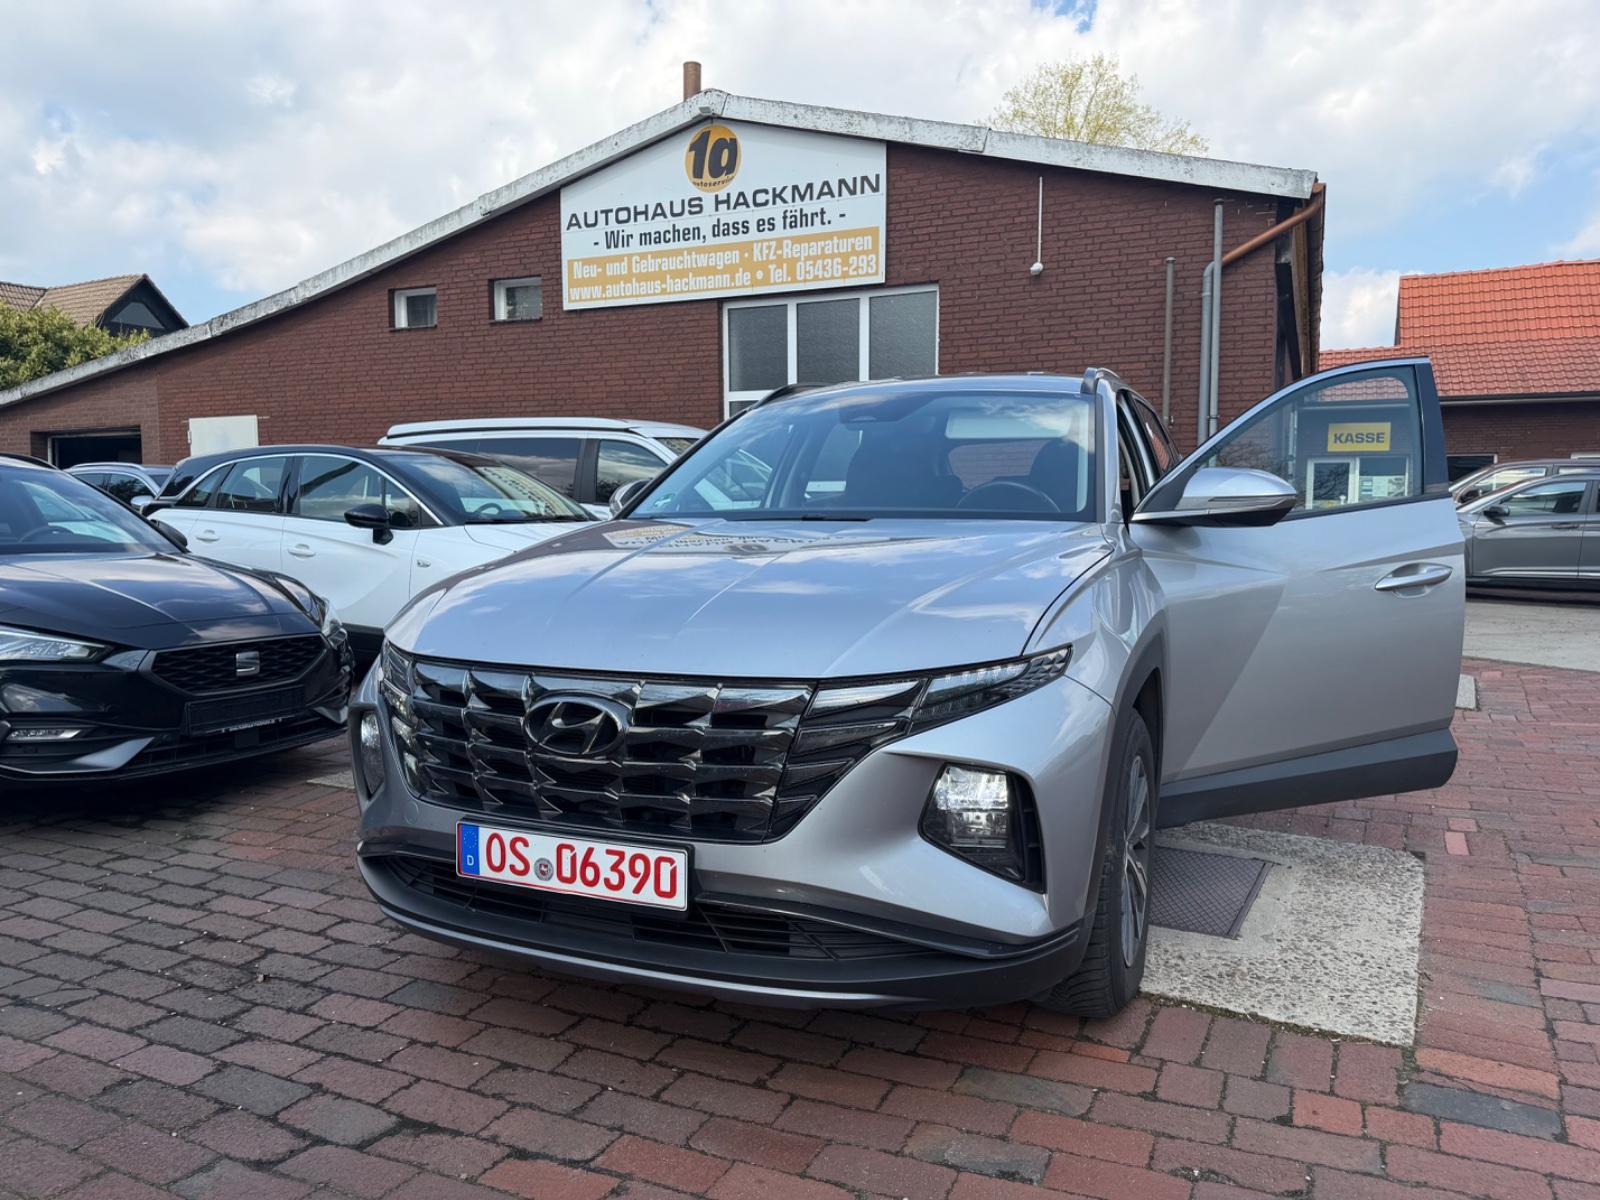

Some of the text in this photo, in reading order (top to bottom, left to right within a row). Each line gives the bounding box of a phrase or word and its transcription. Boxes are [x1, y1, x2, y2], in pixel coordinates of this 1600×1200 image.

[689, 130, 738, 179] 1a
[566, 173, 880, 230] AUTOHAUS HACKMANN
[605, 229, 633, 249] Wir
[639, 223, 706, 246] machen,
[712, 217, 750, 238] dass
[756, 216, 776, 233] es
[782, 207, 831, 230] fährt.
[570, 255, 877, 301] www.autohaus-hackmann.de Tel. 05436-293
[573, 235, 872, 279] Neu- und Gebrauchtwagen KFZ-Reparaturen
[1333, 432, 1385, 444] KASSE
[466, 855, 474, 866] D
[485, 832, 530, 877] OS
[556, 843, 677, 899] 06390
